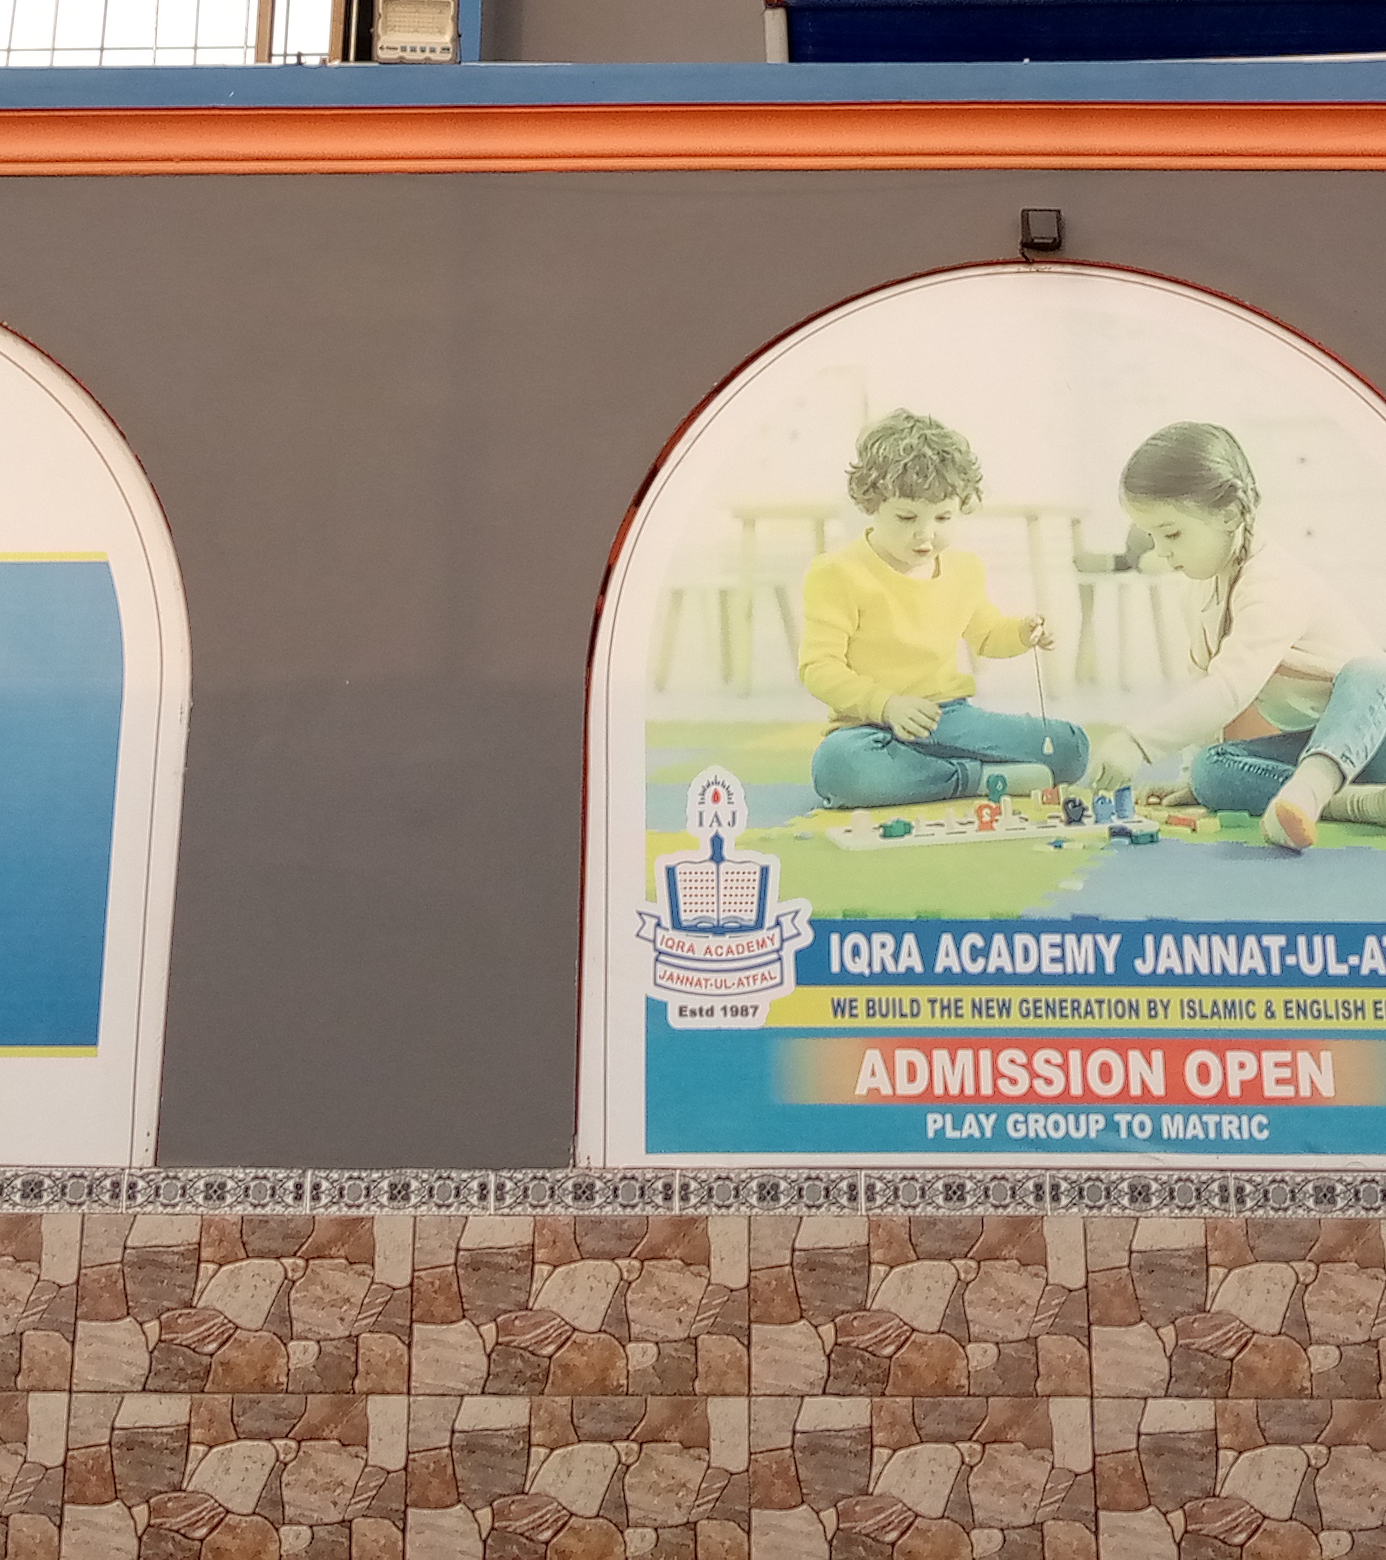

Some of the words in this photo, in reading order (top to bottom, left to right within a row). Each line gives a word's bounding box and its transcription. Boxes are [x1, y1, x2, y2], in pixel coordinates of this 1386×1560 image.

[659, 933, 696, 956] IQRA
[703, 932, 777, 958] ACADEMY
[829, 931, 925, 977] IQRA
[934, 931, 1123, 976] ACADEMY
[678, 1005, 715, 1018] Estd
[720, 1005, 760, 1018] 1987
[831, 997, 861, 1018] WE
[866, 997, 921, 1019] BUILD
[928, 997, 964, 1019] THE
[971, 997, 1012, 1019] NEW
[1018, 997, 1140, 1020] GENERATION
[1147, 998, 1172, 1020] BY
[1180, 998, 1257, 1020] ISLAMIC
[1264, 999, 1277, 1020] &
[1283, 998, 1366, 1021] ENGLISH
[854, 1046, 1166, 1099] ADMISSION
[1183, 1048, 1337, 1099] OPEN
[926, 1112, 998, 1140] PLAY
[1007, 1112, 1106, 1140] GROUP
[1114, 1113, 1154, 1140] TO
[1161, 1113, 1271, 1141] MATRIC
